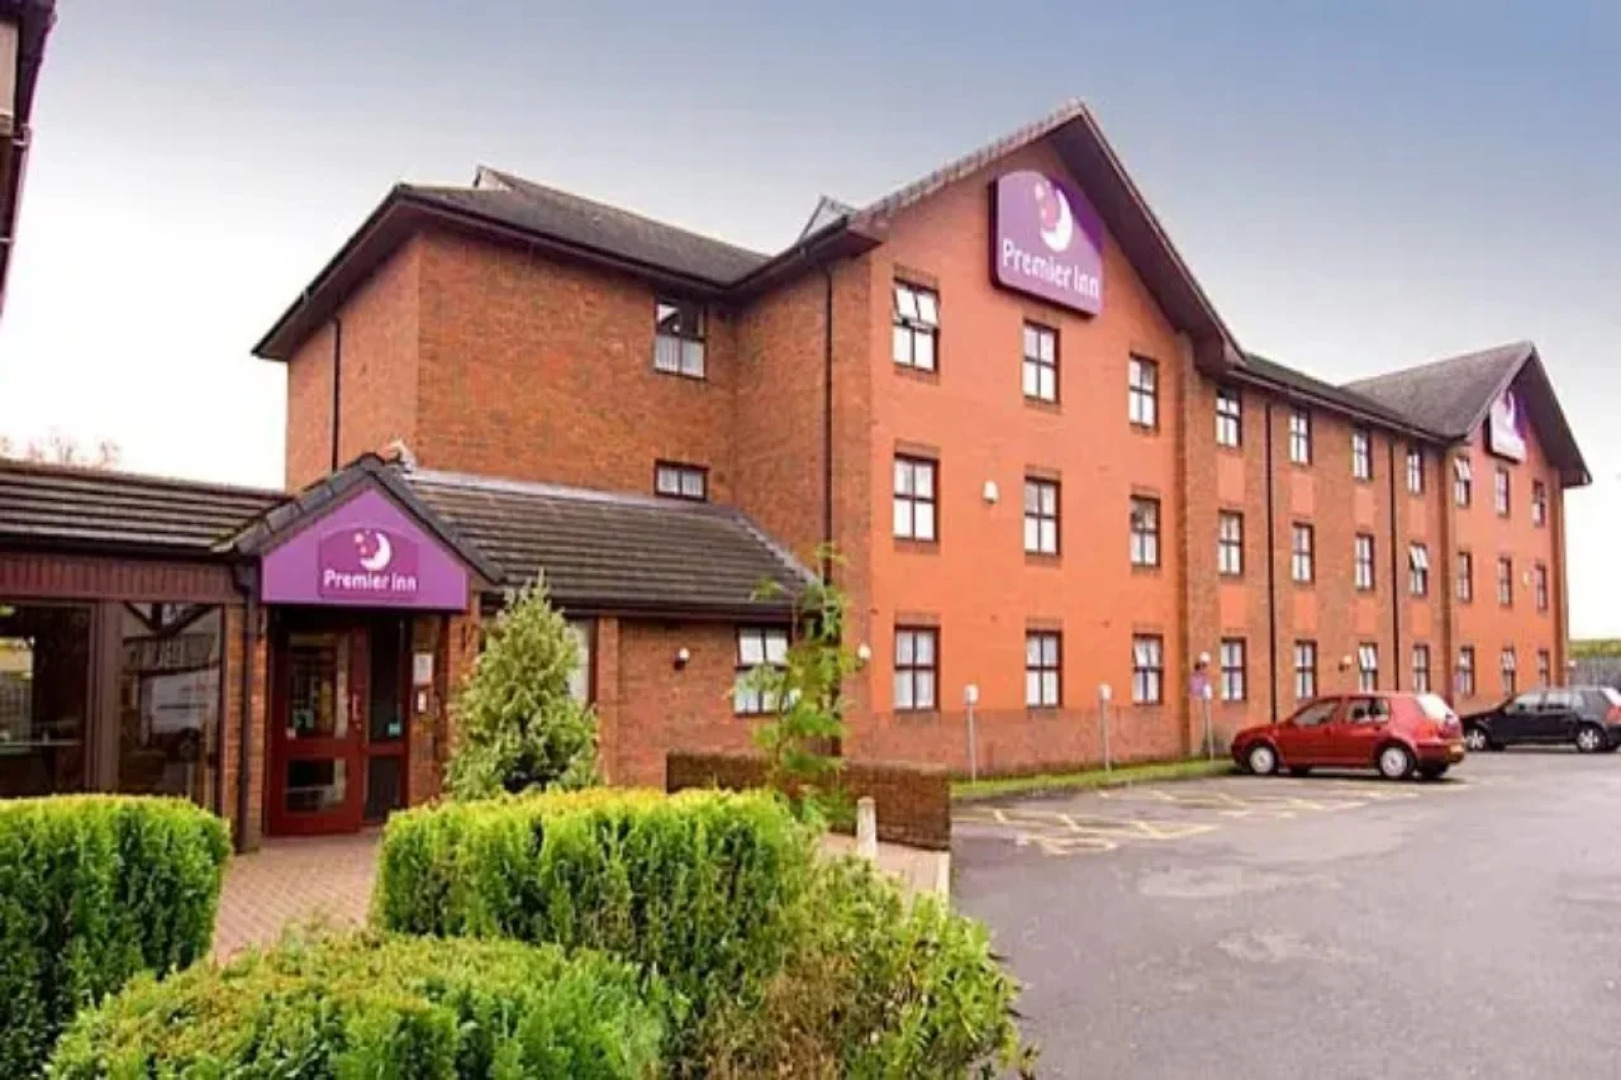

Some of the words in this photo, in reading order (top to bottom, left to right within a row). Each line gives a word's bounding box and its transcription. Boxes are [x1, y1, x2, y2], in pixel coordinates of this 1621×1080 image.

[1002, 238, 1072, 290] Premier
[1073, 264, 1100, 299] Inn
[323, 569, 390, 590] Premier
[391, 572, 416, 591] Inn
